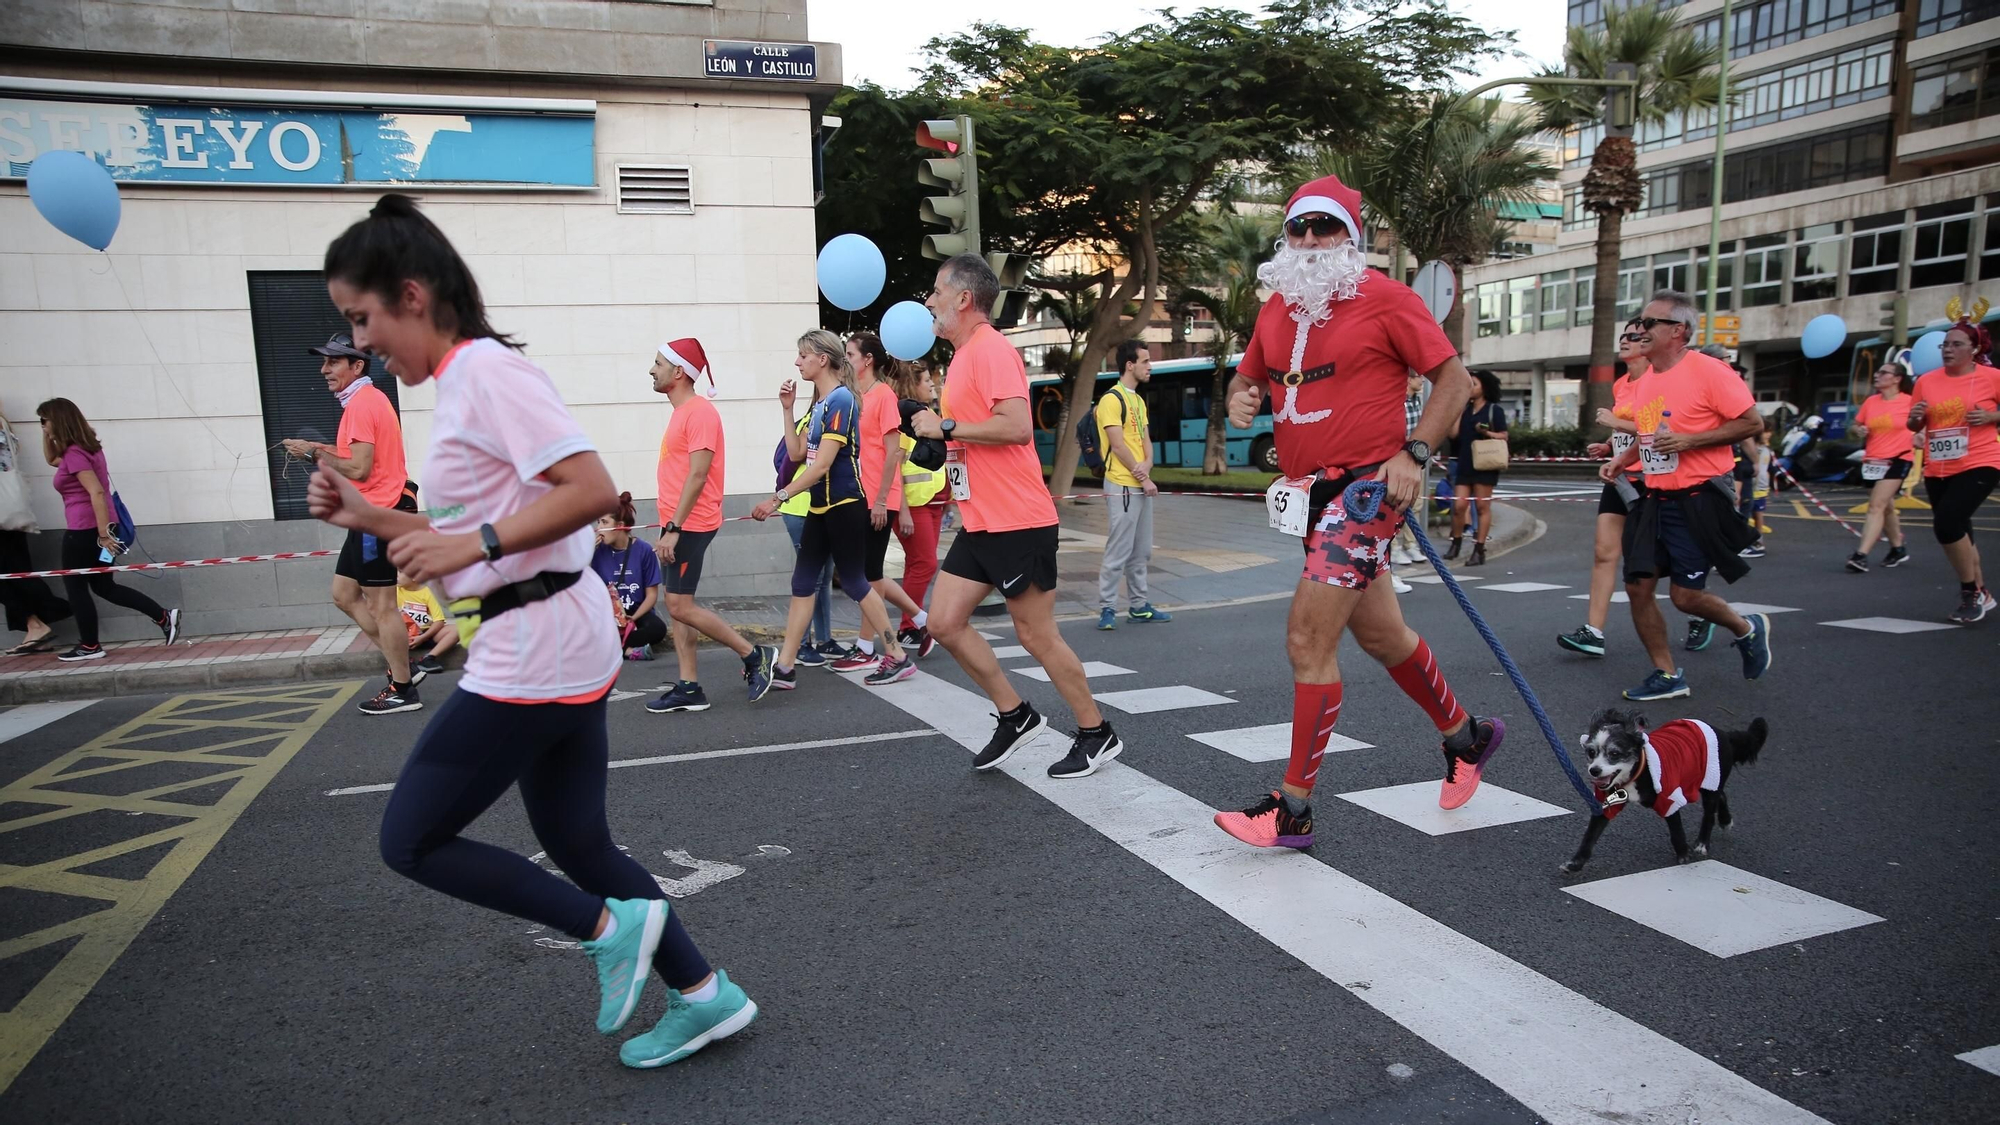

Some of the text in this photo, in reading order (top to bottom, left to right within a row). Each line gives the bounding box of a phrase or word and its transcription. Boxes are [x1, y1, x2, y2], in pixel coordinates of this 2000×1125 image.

[753, 46, 789, 57] CALLE
[708, 56, 813, 76] LEÓN Y CASTILLO
[0, 108, 322, 172] SEPEYO
[1614, 435, 1636, 448] 7042
[1929, 439, 1960, 453] 3091
